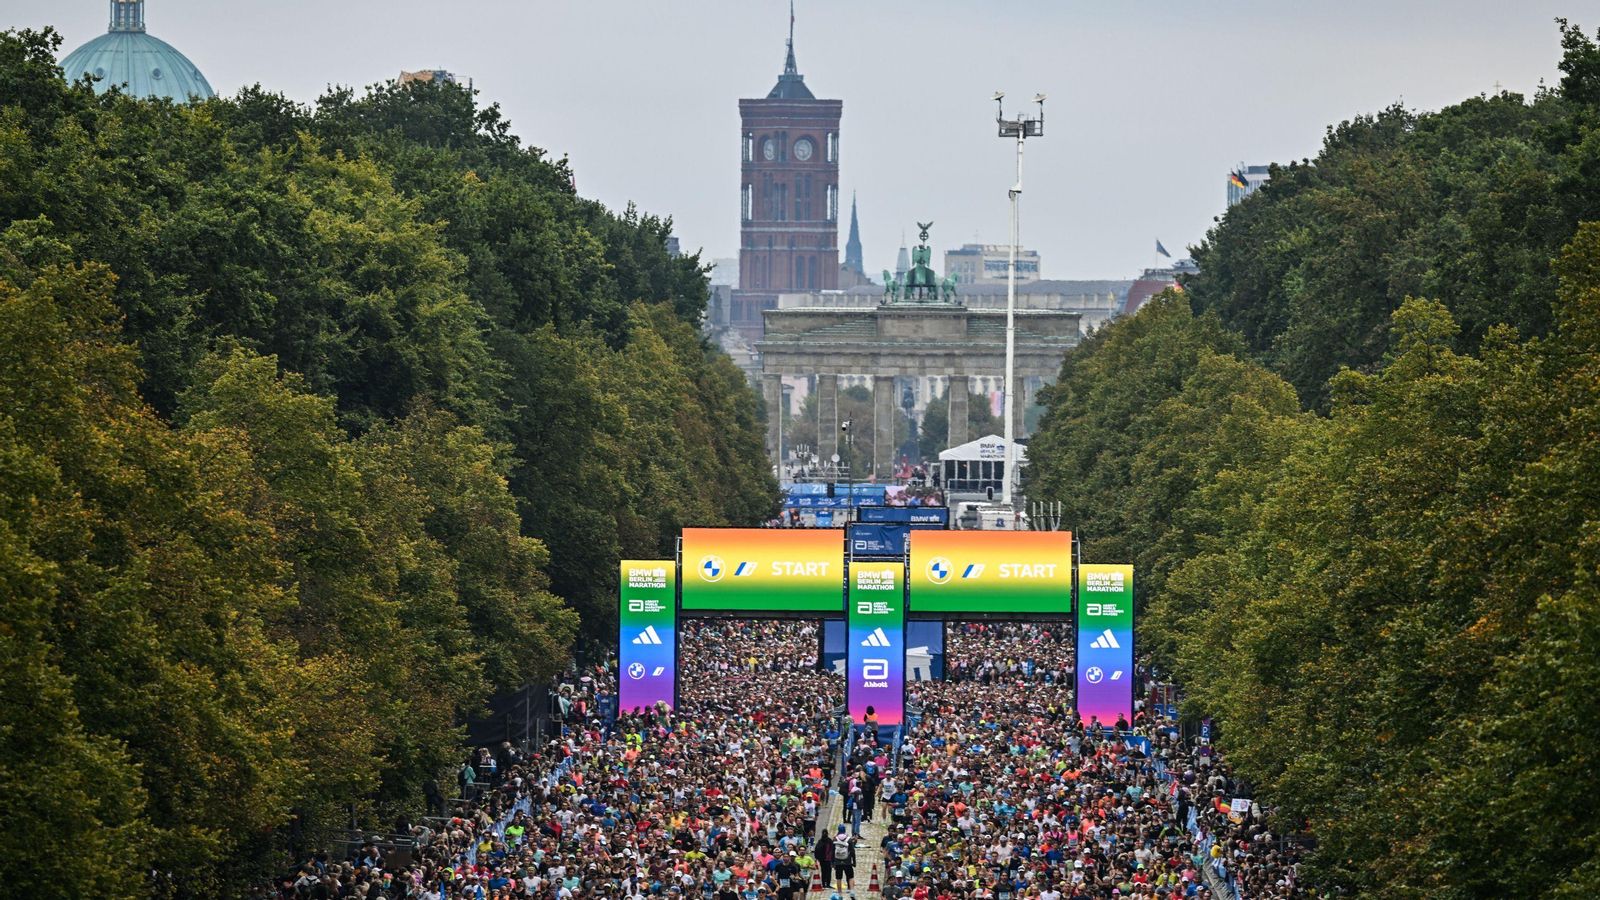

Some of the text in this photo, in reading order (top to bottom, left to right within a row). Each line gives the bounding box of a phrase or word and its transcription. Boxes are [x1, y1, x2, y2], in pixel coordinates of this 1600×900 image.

[628, 568, 652, 577] BMW
[771, 561, 830, 576] START
[998, 563, 1056, 578] START
[857, 571, 881, 579] BMW
[1087, 572, 1110, 580] BMW
